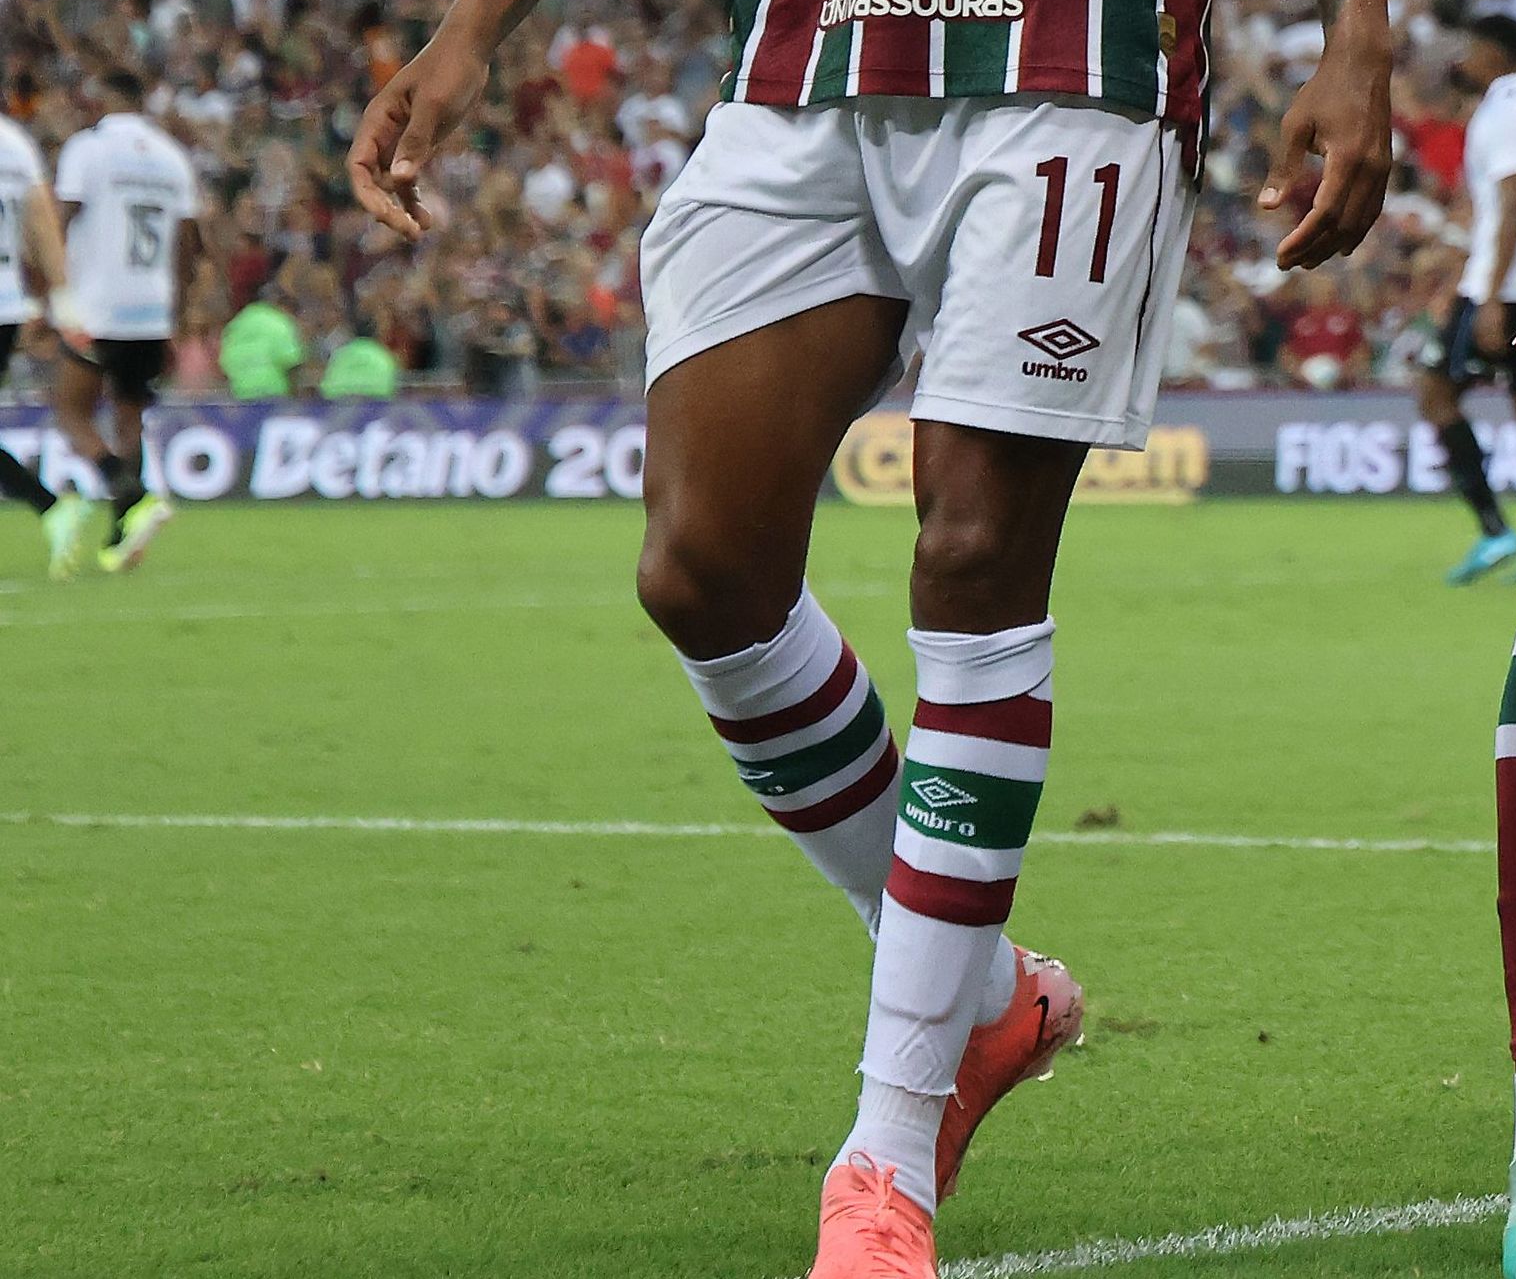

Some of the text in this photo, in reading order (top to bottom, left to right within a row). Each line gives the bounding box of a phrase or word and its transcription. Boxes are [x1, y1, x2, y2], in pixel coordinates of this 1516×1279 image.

[1036, 156, 1120, 283] 11
[1022, 360, 1088, 383] umbro
[250, 418, 532, 499] Betano
[1274, 421, 1398, 494] FIOS
[905, 802, 977, 837] umbro
